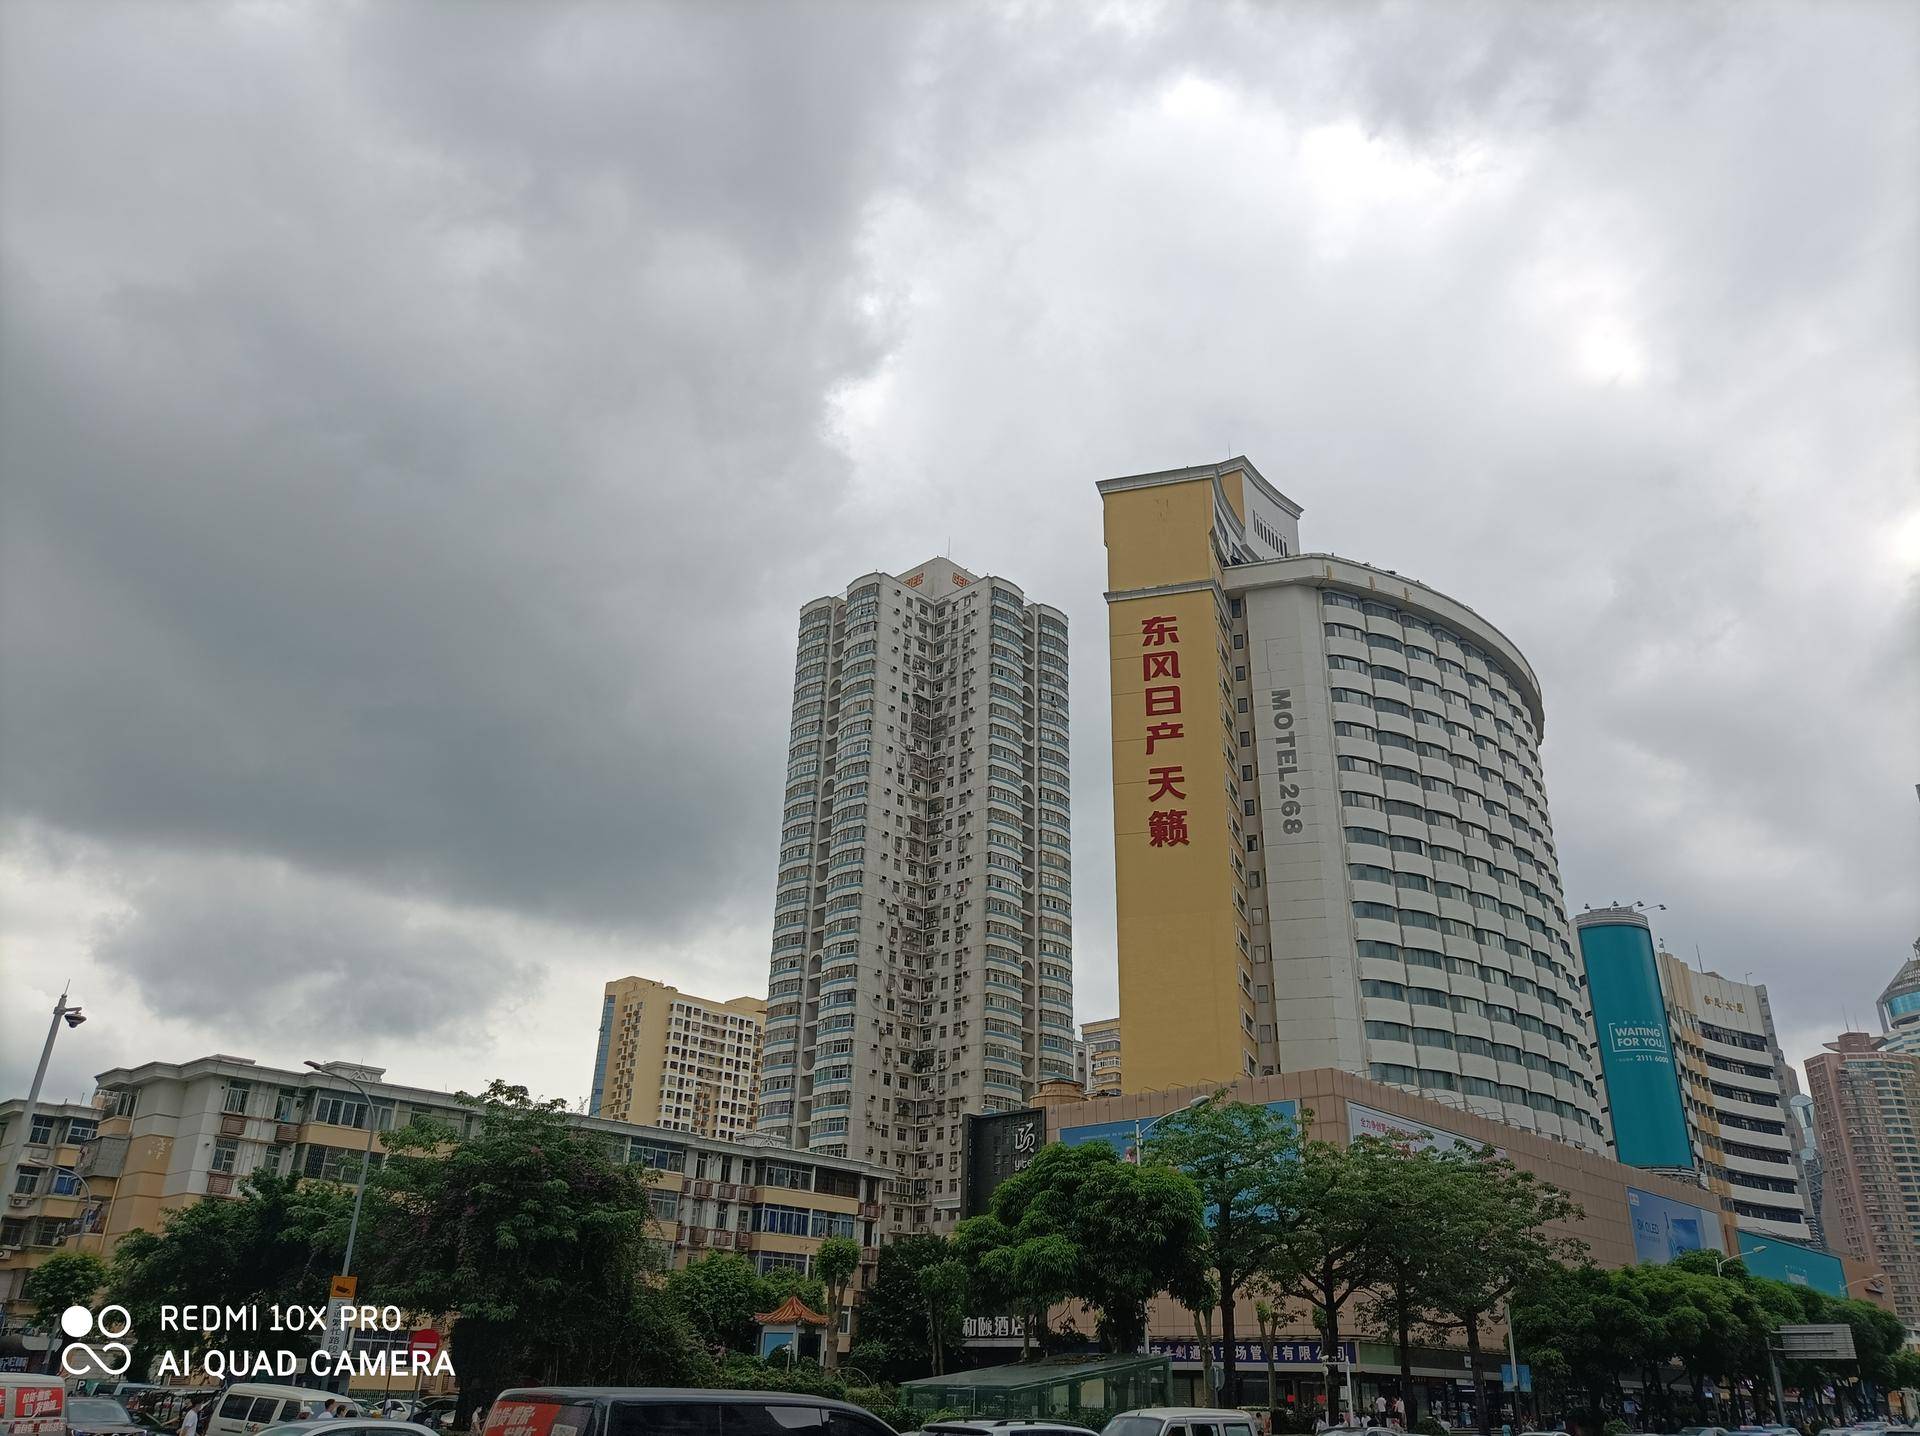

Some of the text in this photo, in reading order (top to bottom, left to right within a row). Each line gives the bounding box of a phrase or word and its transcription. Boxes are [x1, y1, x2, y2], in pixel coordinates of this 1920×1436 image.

[1271, 688, 1303, 835] MOTEL268
[1615, 1027, 1660, 1037] WAITING
[1617, 1037, 1640, 1047] FOR
[77, 1380, 86, 1390] P
